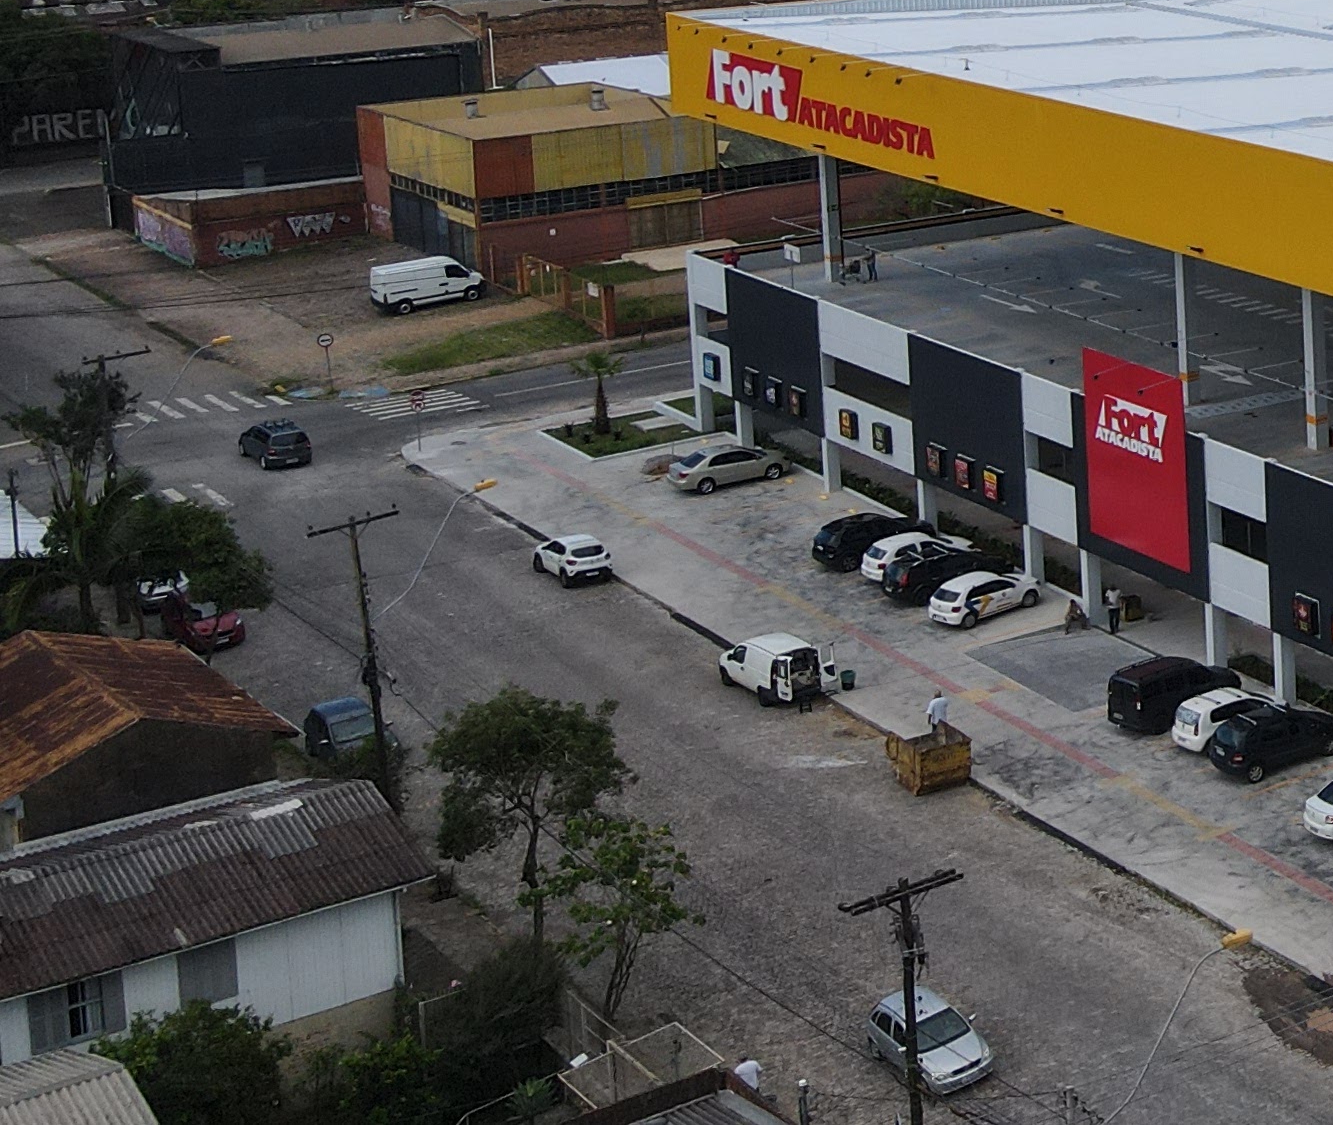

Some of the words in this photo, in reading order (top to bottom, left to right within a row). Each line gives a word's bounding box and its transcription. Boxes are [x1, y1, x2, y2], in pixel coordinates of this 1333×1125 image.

[712, 48, 788, 121] Fort
[798, 97, 935, 159] ATACADISTA
[1095, 425, 1163, 463] ATACADISTA
[1103, 395, 1160, 448] Fort
